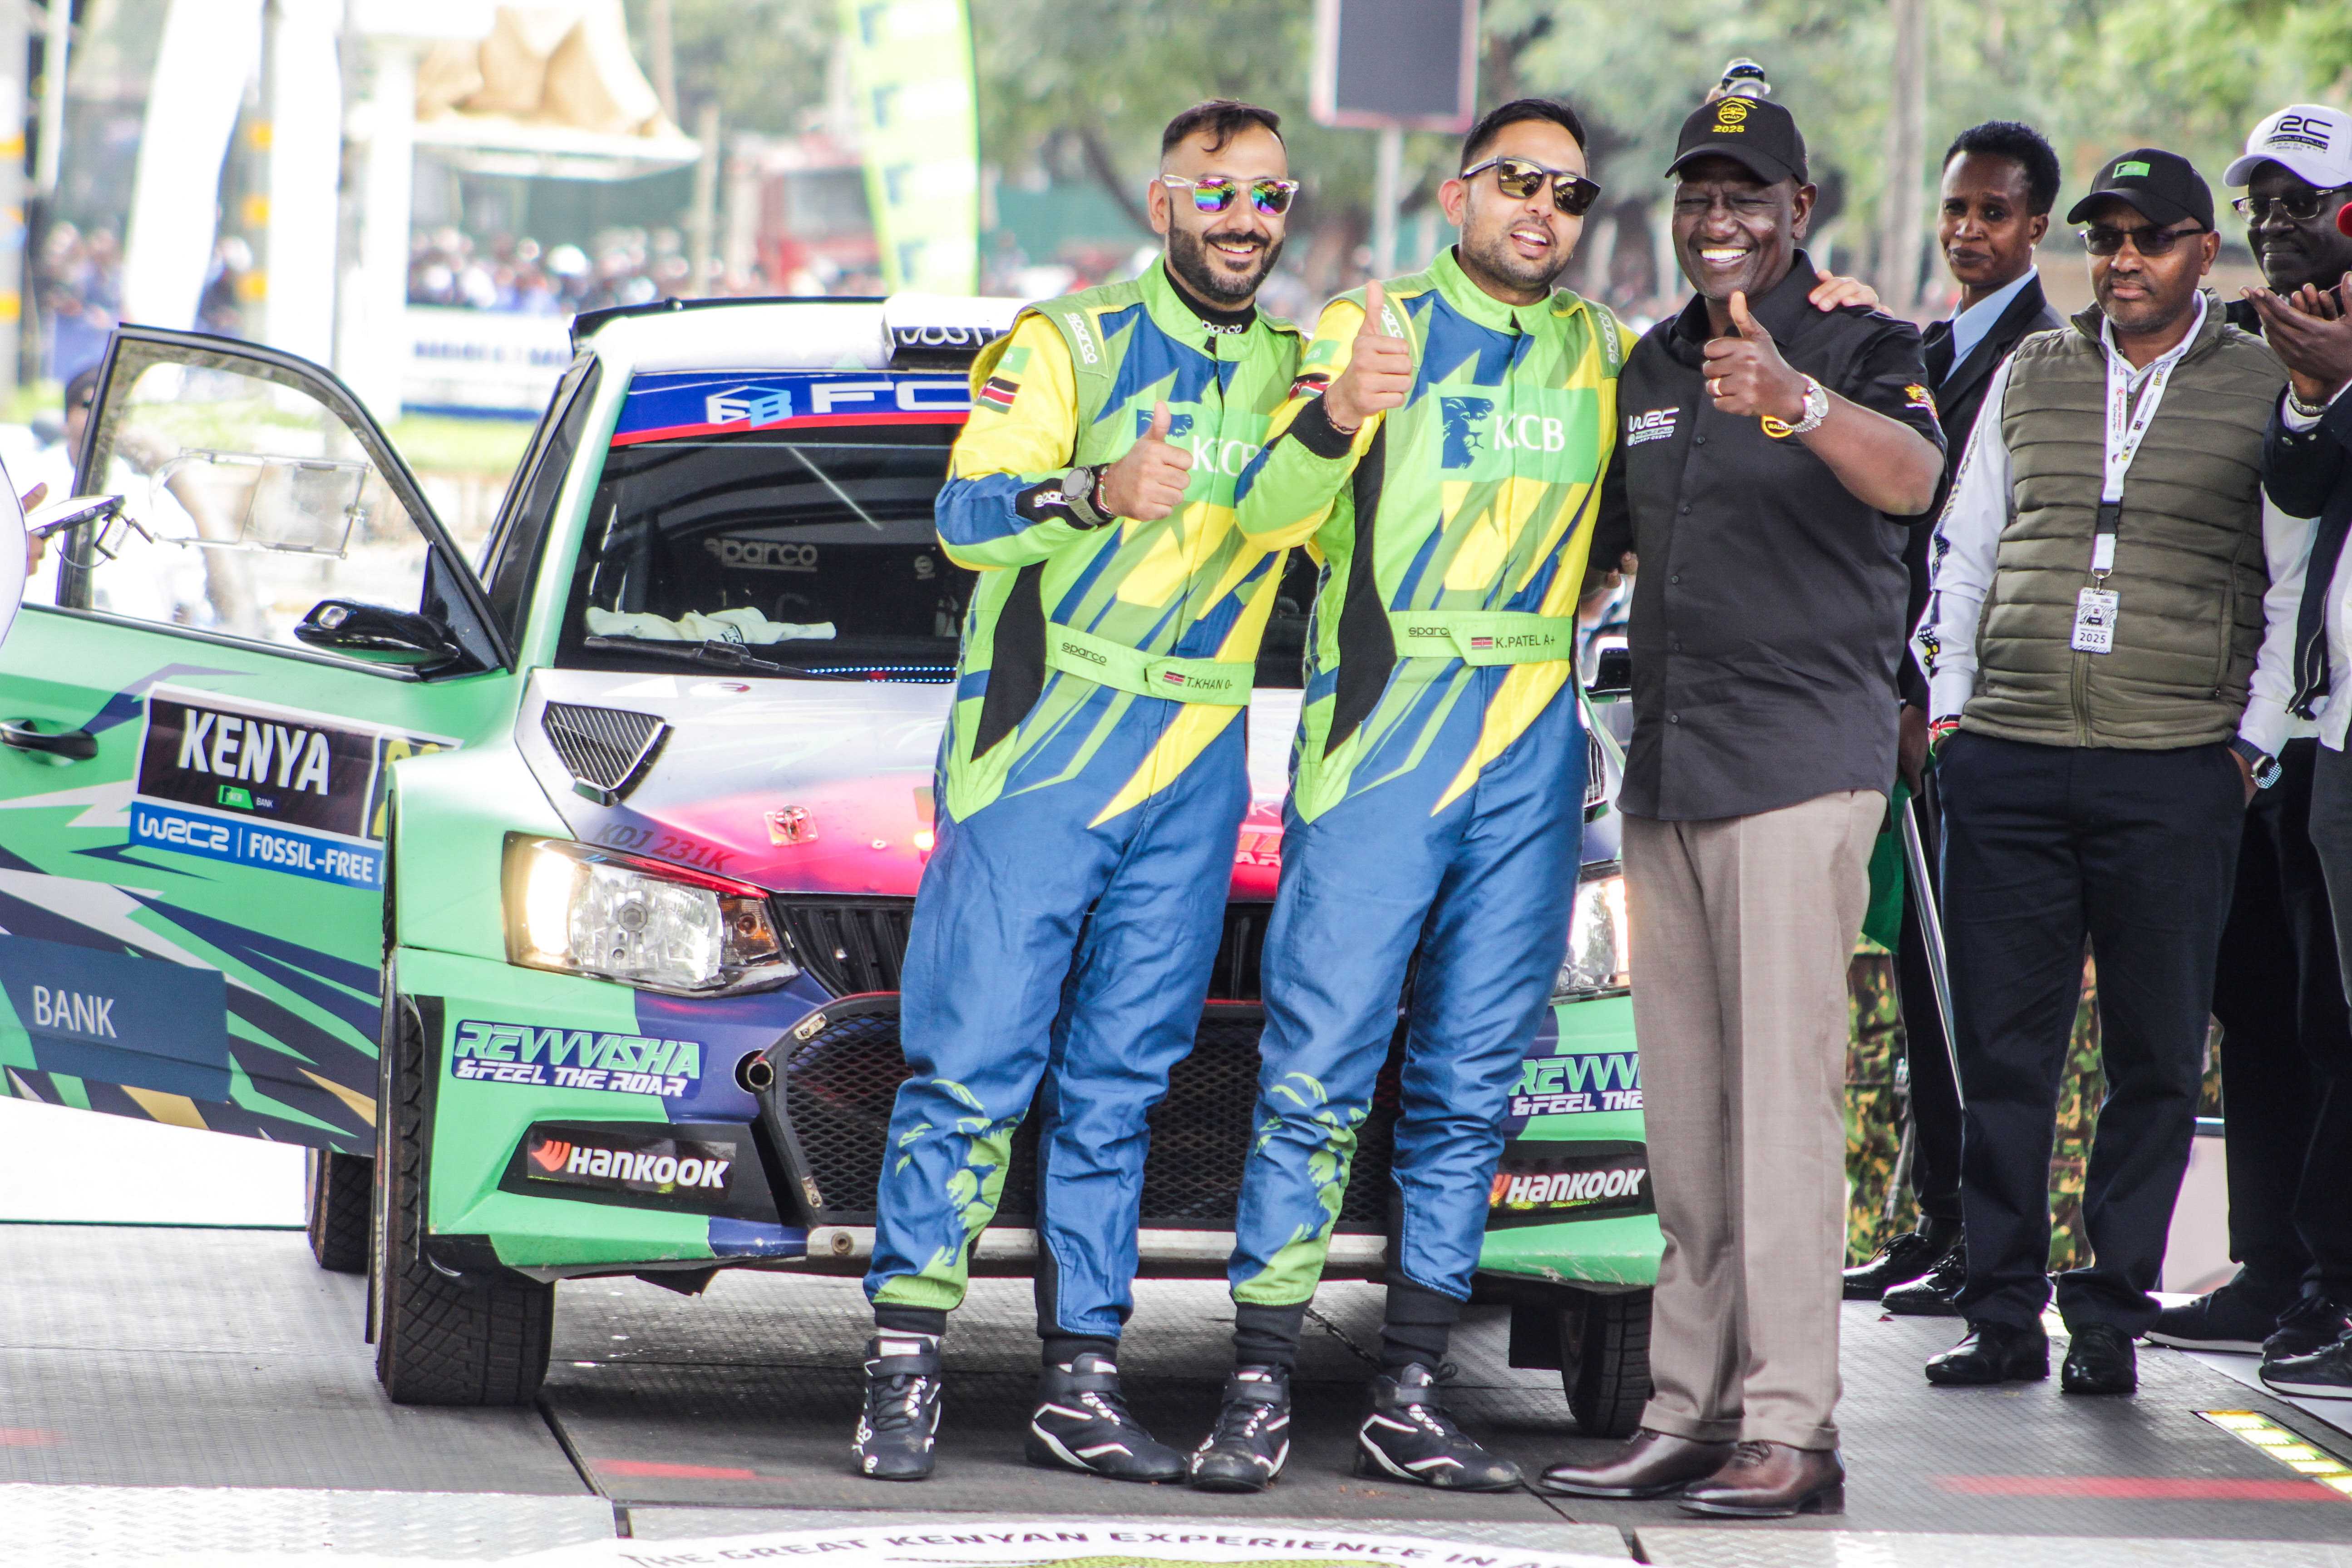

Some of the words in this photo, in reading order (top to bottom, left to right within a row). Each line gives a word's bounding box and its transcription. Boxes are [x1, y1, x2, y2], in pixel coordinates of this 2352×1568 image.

[1063, 312, 1098, 365] sparco
[1597, 311, 1620, 365] sparco
[1494, 412, 1566, 453] KCB
[1627, 407, 1680, 432] WRC
[704, 537, 818, 571] sparco
[1496, 636, 1541, 649] K.PATEL
[2080, 632, 2107, 644] 2025
[1061, 642, 1107, 666] sparco
[1187, 676, 1223, 690] T.KHAN
[178, 708, 330, 795] KENYA
[256, 797, 274, 808] BANK
[138, 812, 230, 852] WRC2
[248, 832, 375, 882] FOSSIL-FREE
[594, 823, 654, 849] KDJ
[651, 835, 736, 873] 231K
[33, 985, 117, 1038] BANK
[454, 1021, 701, 1080] REVVVISHA
[552, 1066, 610, 1090] THE
[607, 1074, 689, 1098] ROAR
[1601, 1090, 1644, 1110] THE
[719, 1539, 869, 1559] GREAT
[883, 1532, 1089, 1546] KENYAN
[1109, 1532, 1432, 1558] EXPERIENCE
[1445, 1553, 1498, 1565] IN
